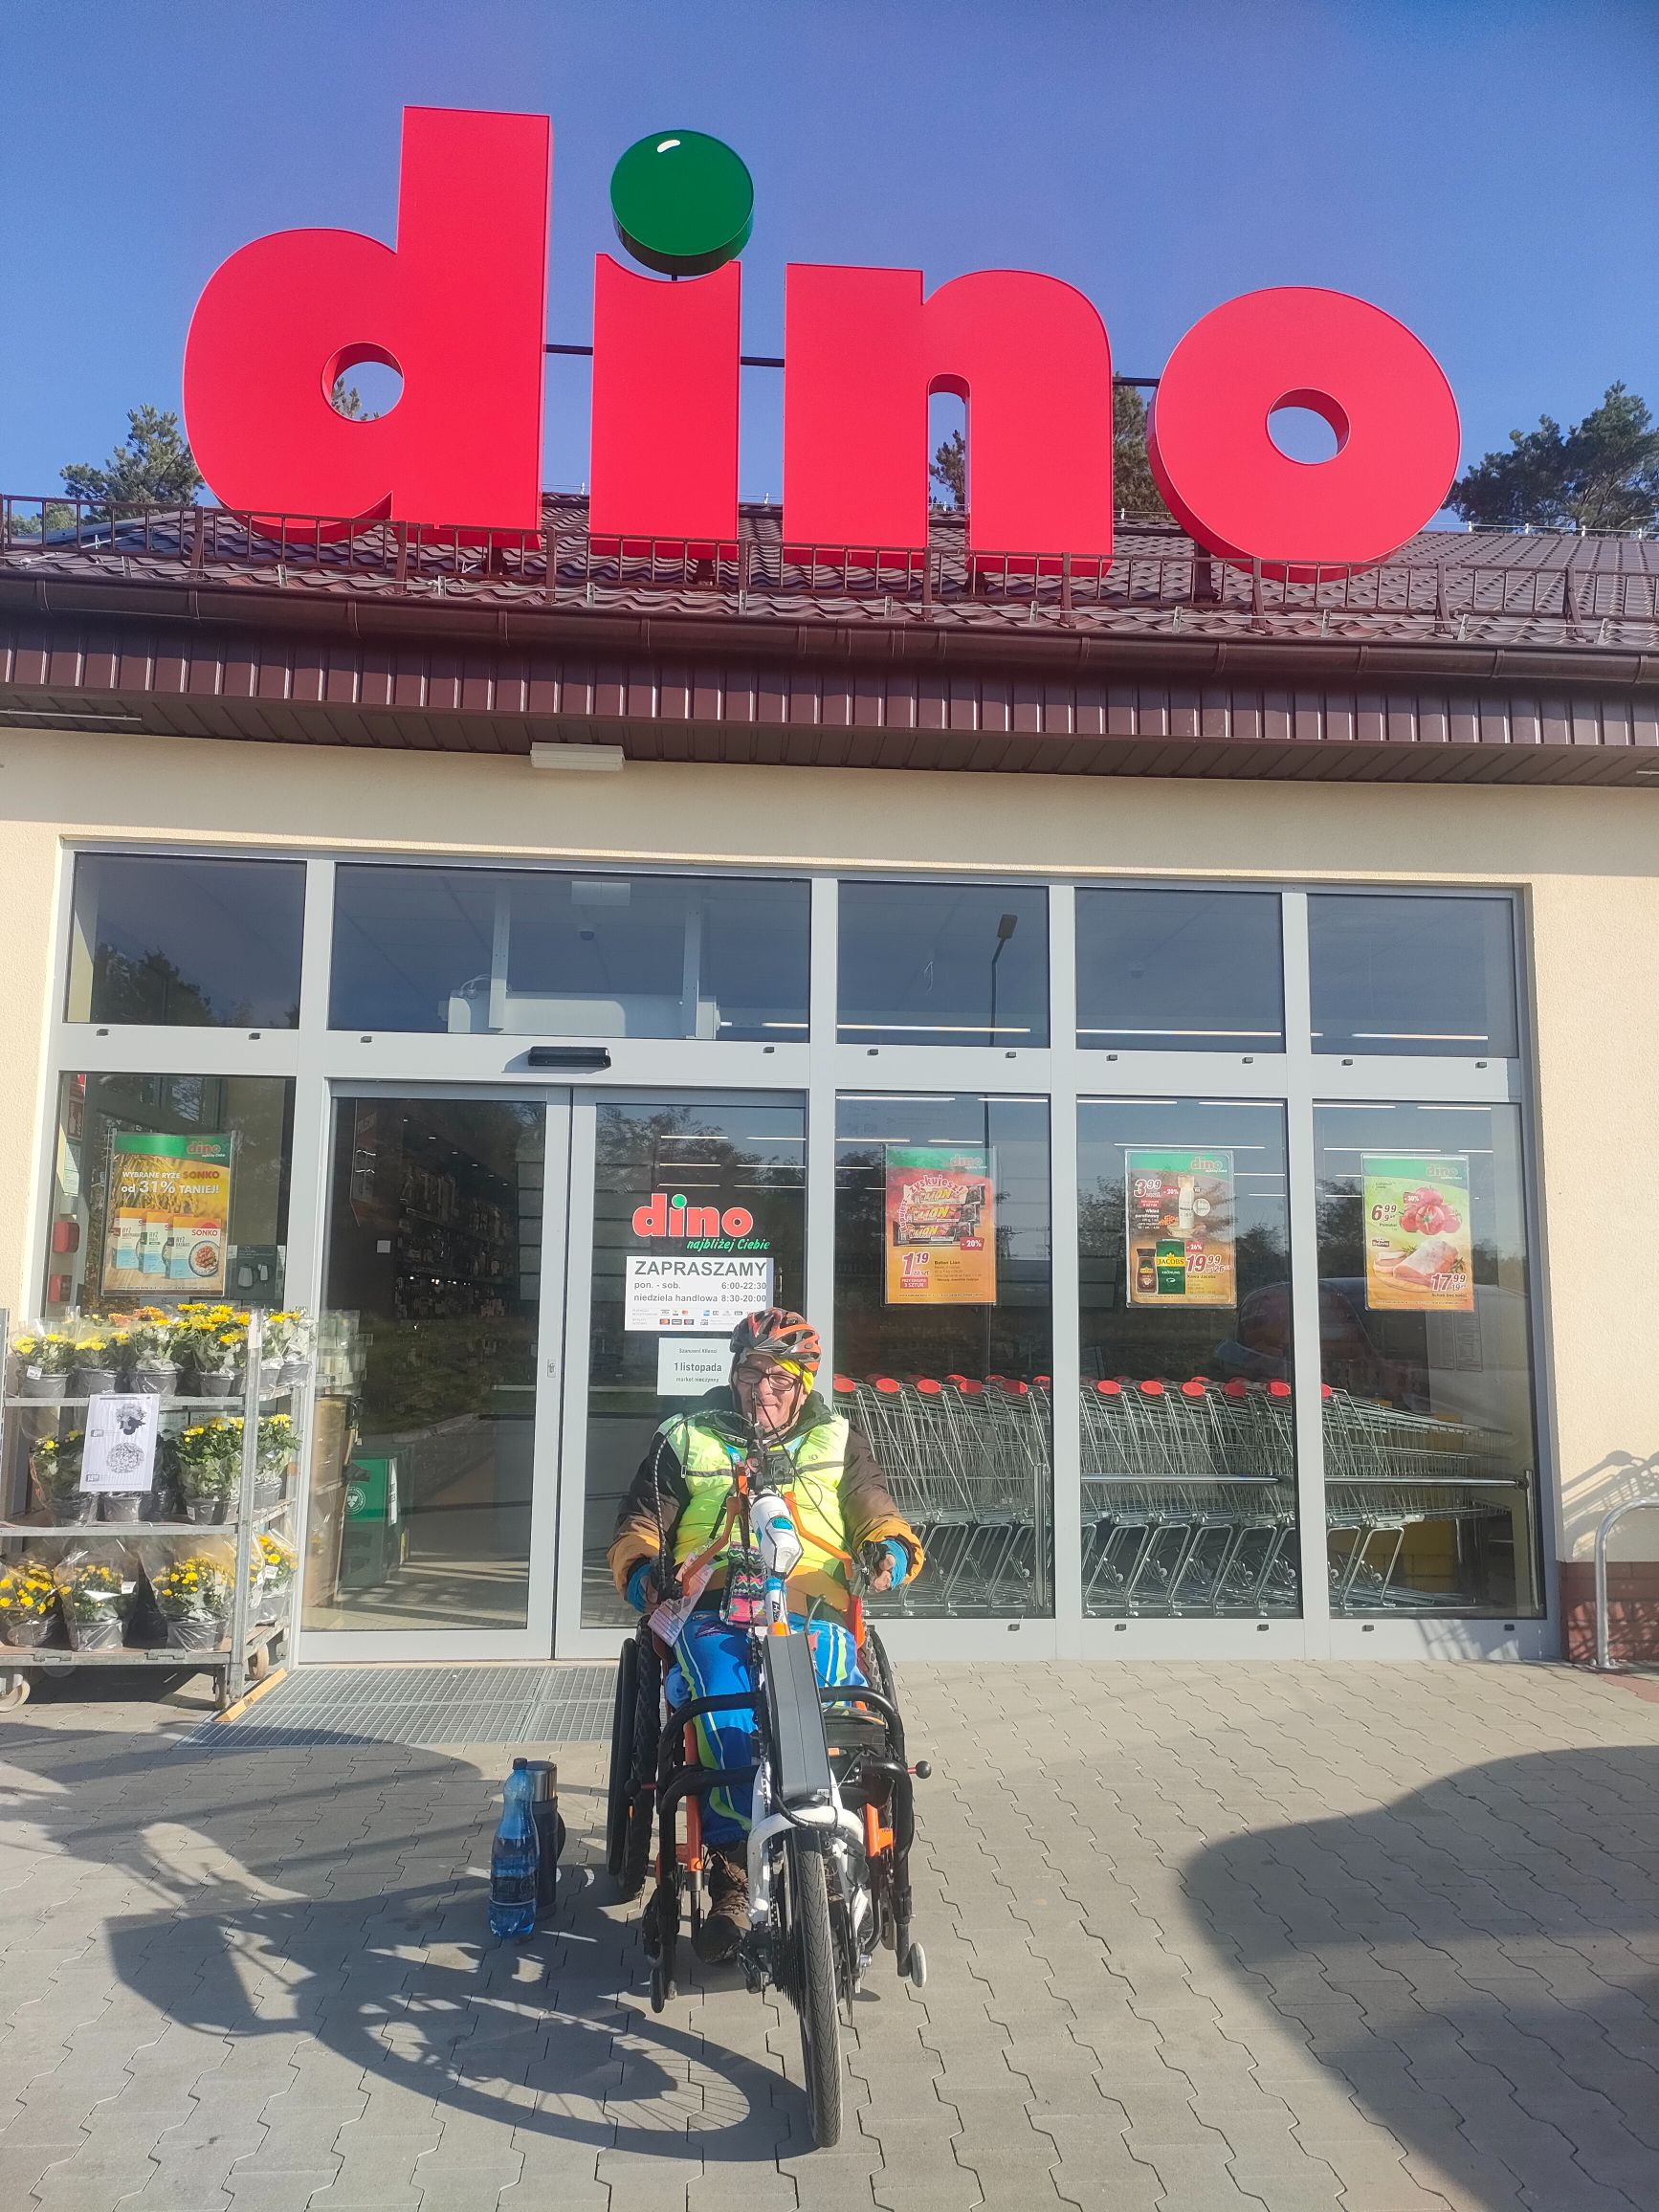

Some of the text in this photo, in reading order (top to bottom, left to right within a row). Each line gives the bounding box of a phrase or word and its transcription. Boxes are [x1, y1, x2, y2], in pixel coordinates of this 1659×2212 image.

[184, 106, 1460, 583] dino
[187, 1140, 221, 1154] dino
[182, 1170, 220, 1180] SONKO
[121, 1180, 220, 1194] od 31% TANIEJ!
[631, 1192, 754, 1237] dino
[191, 1228, 218, 1237] SONKO
[687, 1238, 770, 1251] najbliżej Ciebie
[634, 1260, 766, 1276] ZAPRASZAMY
[634, 1281, 653, 1290] pon.
[721, 1281, 766, 1290] 6:00-22:30
[633, 1294, 766, 1303] niedziela handlowa 8:30-20:00
[674, 1361, 722, 1373] 1 listopada
